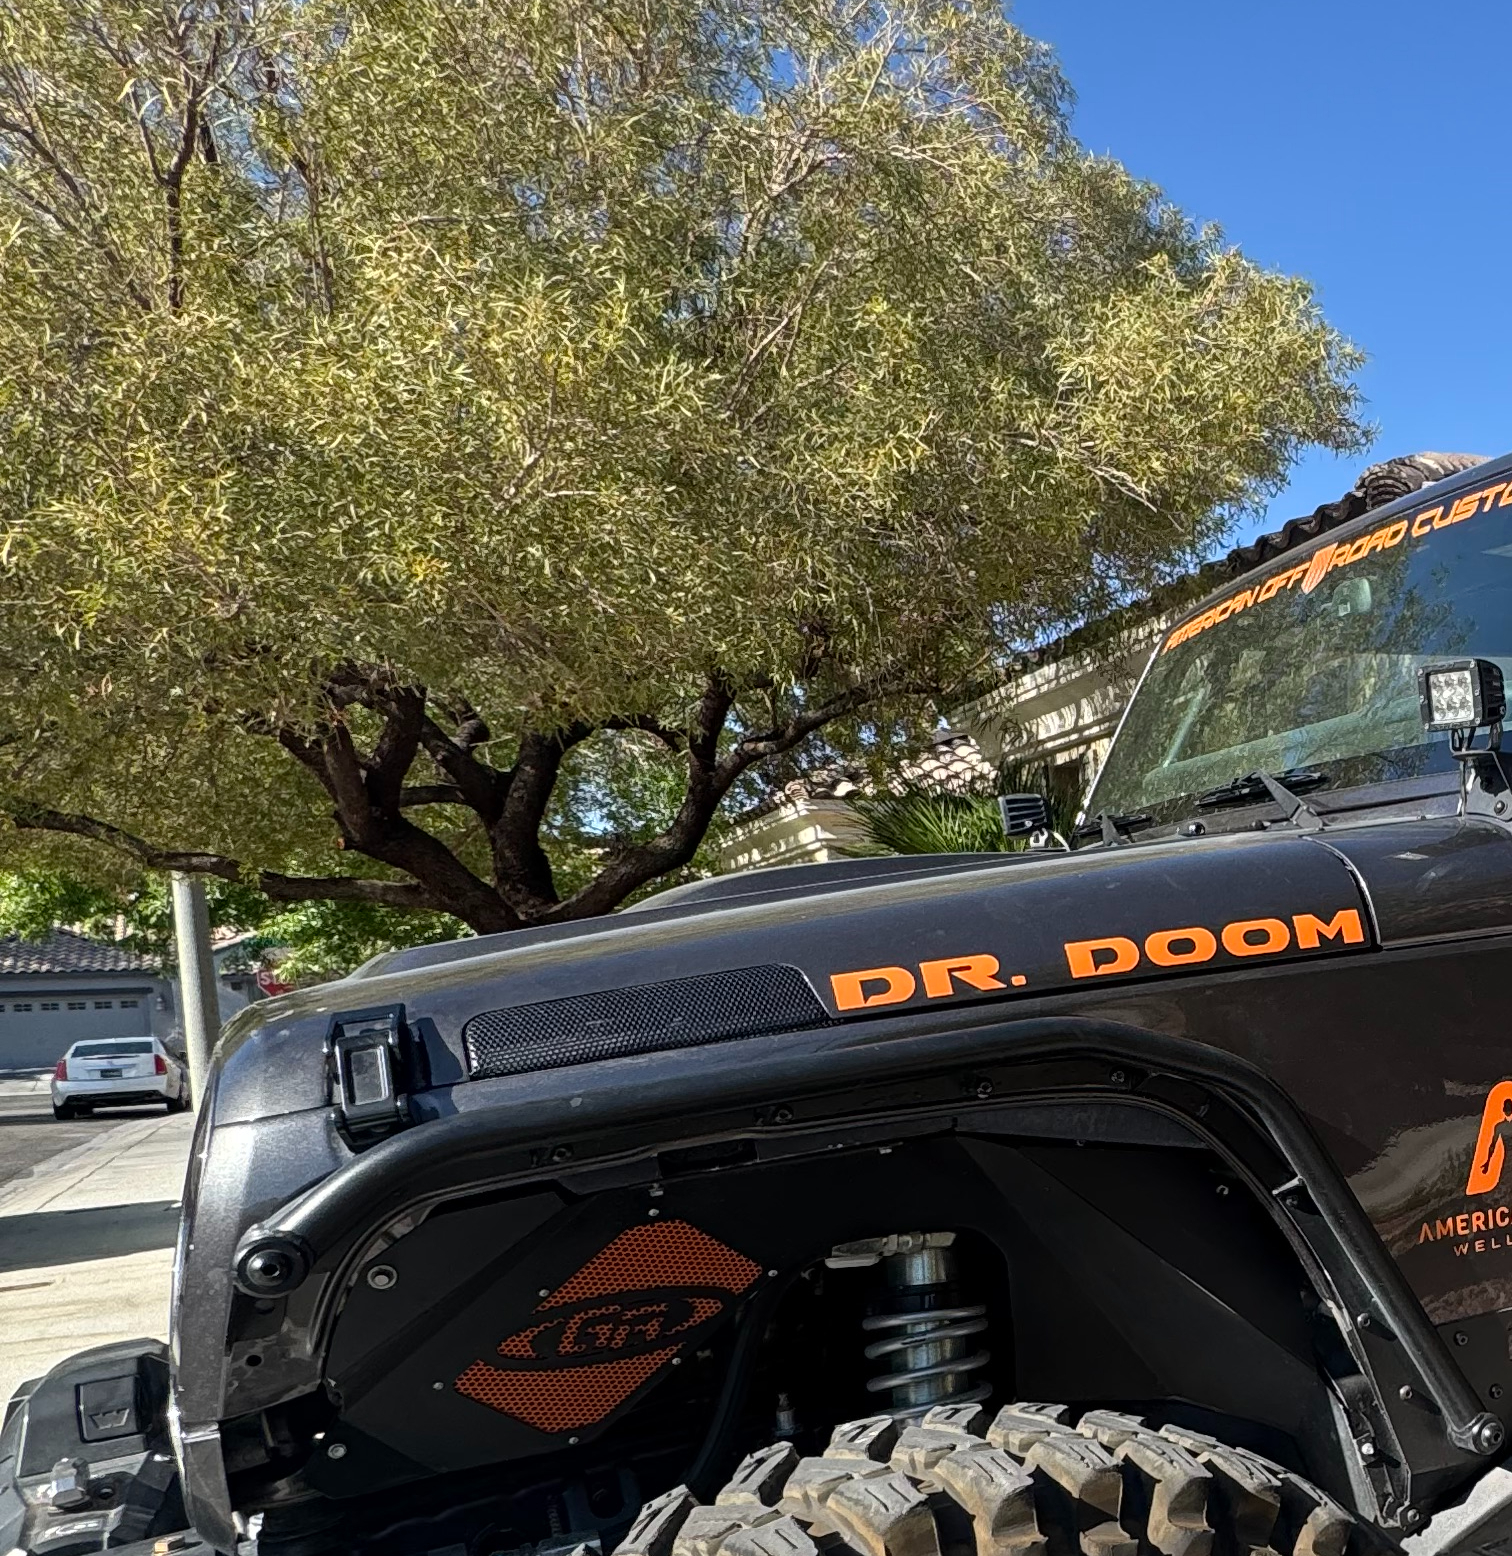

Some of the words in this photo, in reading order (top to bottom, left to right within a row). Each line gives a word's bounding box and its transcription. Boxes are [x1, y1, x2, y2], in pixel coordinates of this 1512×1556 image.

[1163, 590, 1260, 654] AMERICAN
[1257, 558, 1309, 602] OFF
[1329, 518, 1408, 569] ROAD
[829, 953, 1027, 1012] DR.
[1063, 908, 1365, 979] DOOM
